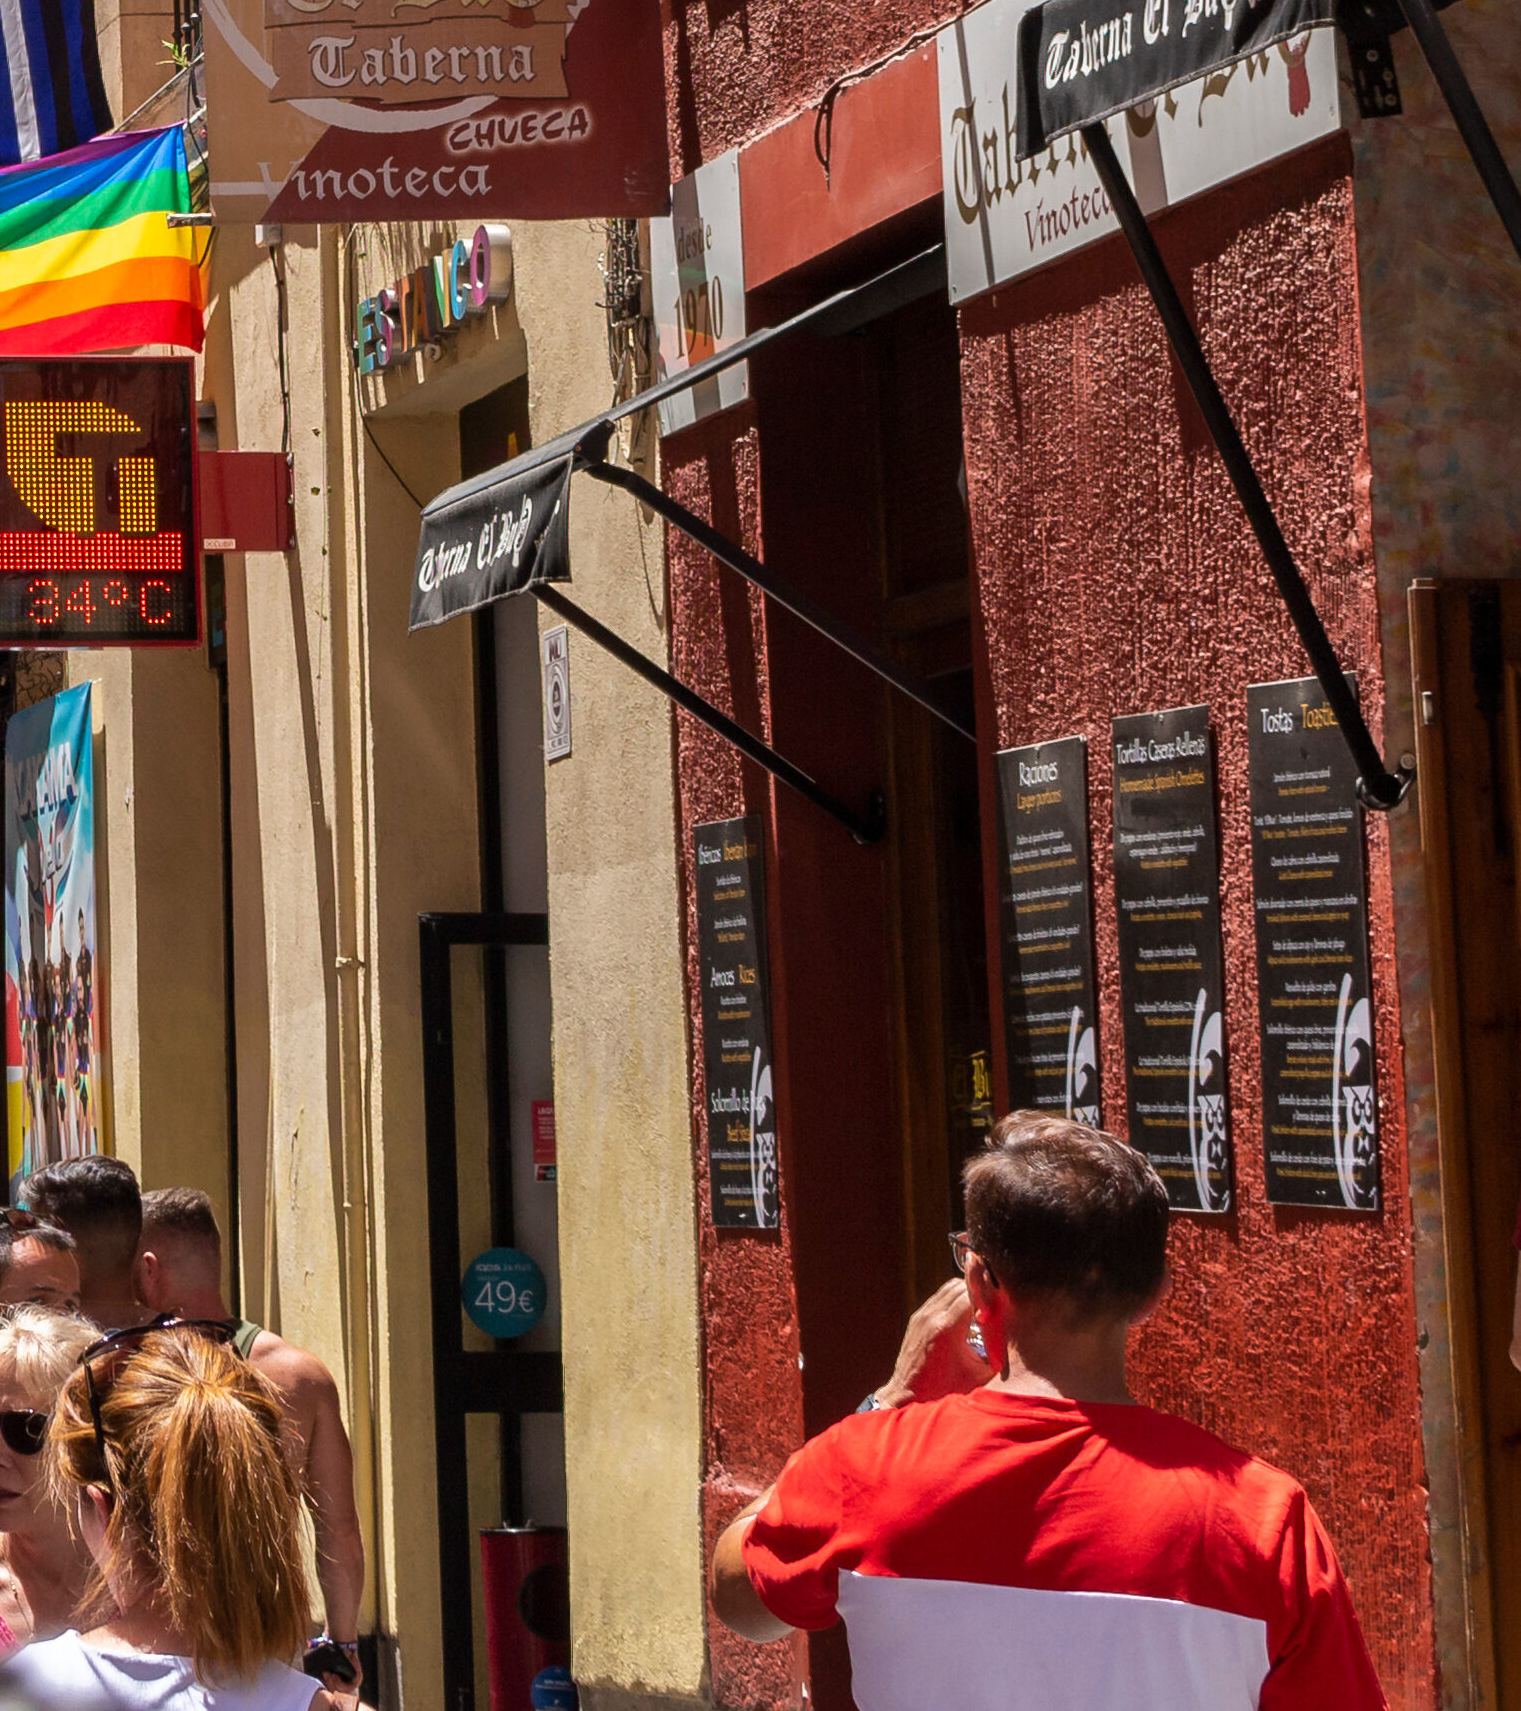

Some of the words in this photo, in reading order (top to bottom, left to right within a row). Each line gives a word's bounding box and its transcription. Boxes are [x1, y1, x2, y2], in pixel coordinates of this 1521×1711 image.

[308, 35, 535, 88] Taberna
[1044, 12, 1133, 91] Taberna
[447, 107, 589, 154] CHUECA
[259, 155, 494, 204] Vinoteca
[356, 224, 511, 375] ESTANCO
[674, 275, 724, 359] 1970
[1260, 706, 1294, 734] Tostas
[1018, 760, 1060, 787] Raciones
[474, 1280, 535, 1314] 49€
